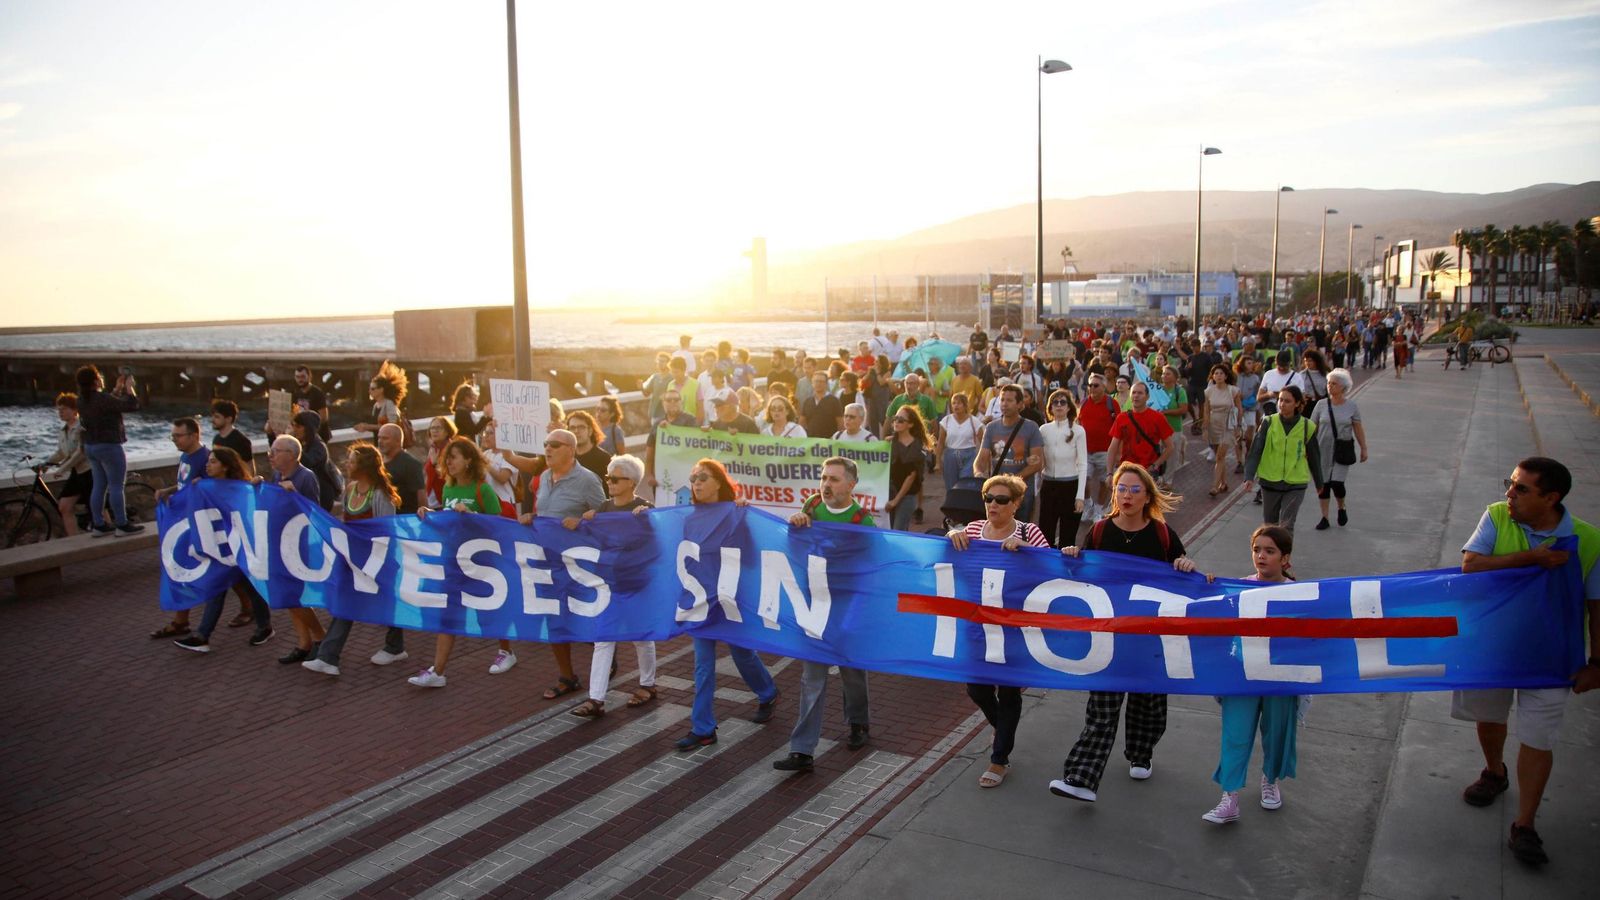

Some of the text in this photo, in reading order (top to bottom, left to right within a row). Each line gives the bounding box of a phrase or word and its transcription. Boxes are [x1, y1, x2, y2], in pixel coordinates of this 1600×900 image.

[520, 385, 540, 407] GATA
[511, 406, 525, 421] NO
[500, 423, 510, 443] SE
[660, 432, 889, 464] Los vecinos y vecinas del parque
[723, 461, 823, 483] mbién QUERE
[736, 483, 794, 504] OVESES
[161, 507, 1446, 684] GENOVESES SIN HOTEL
